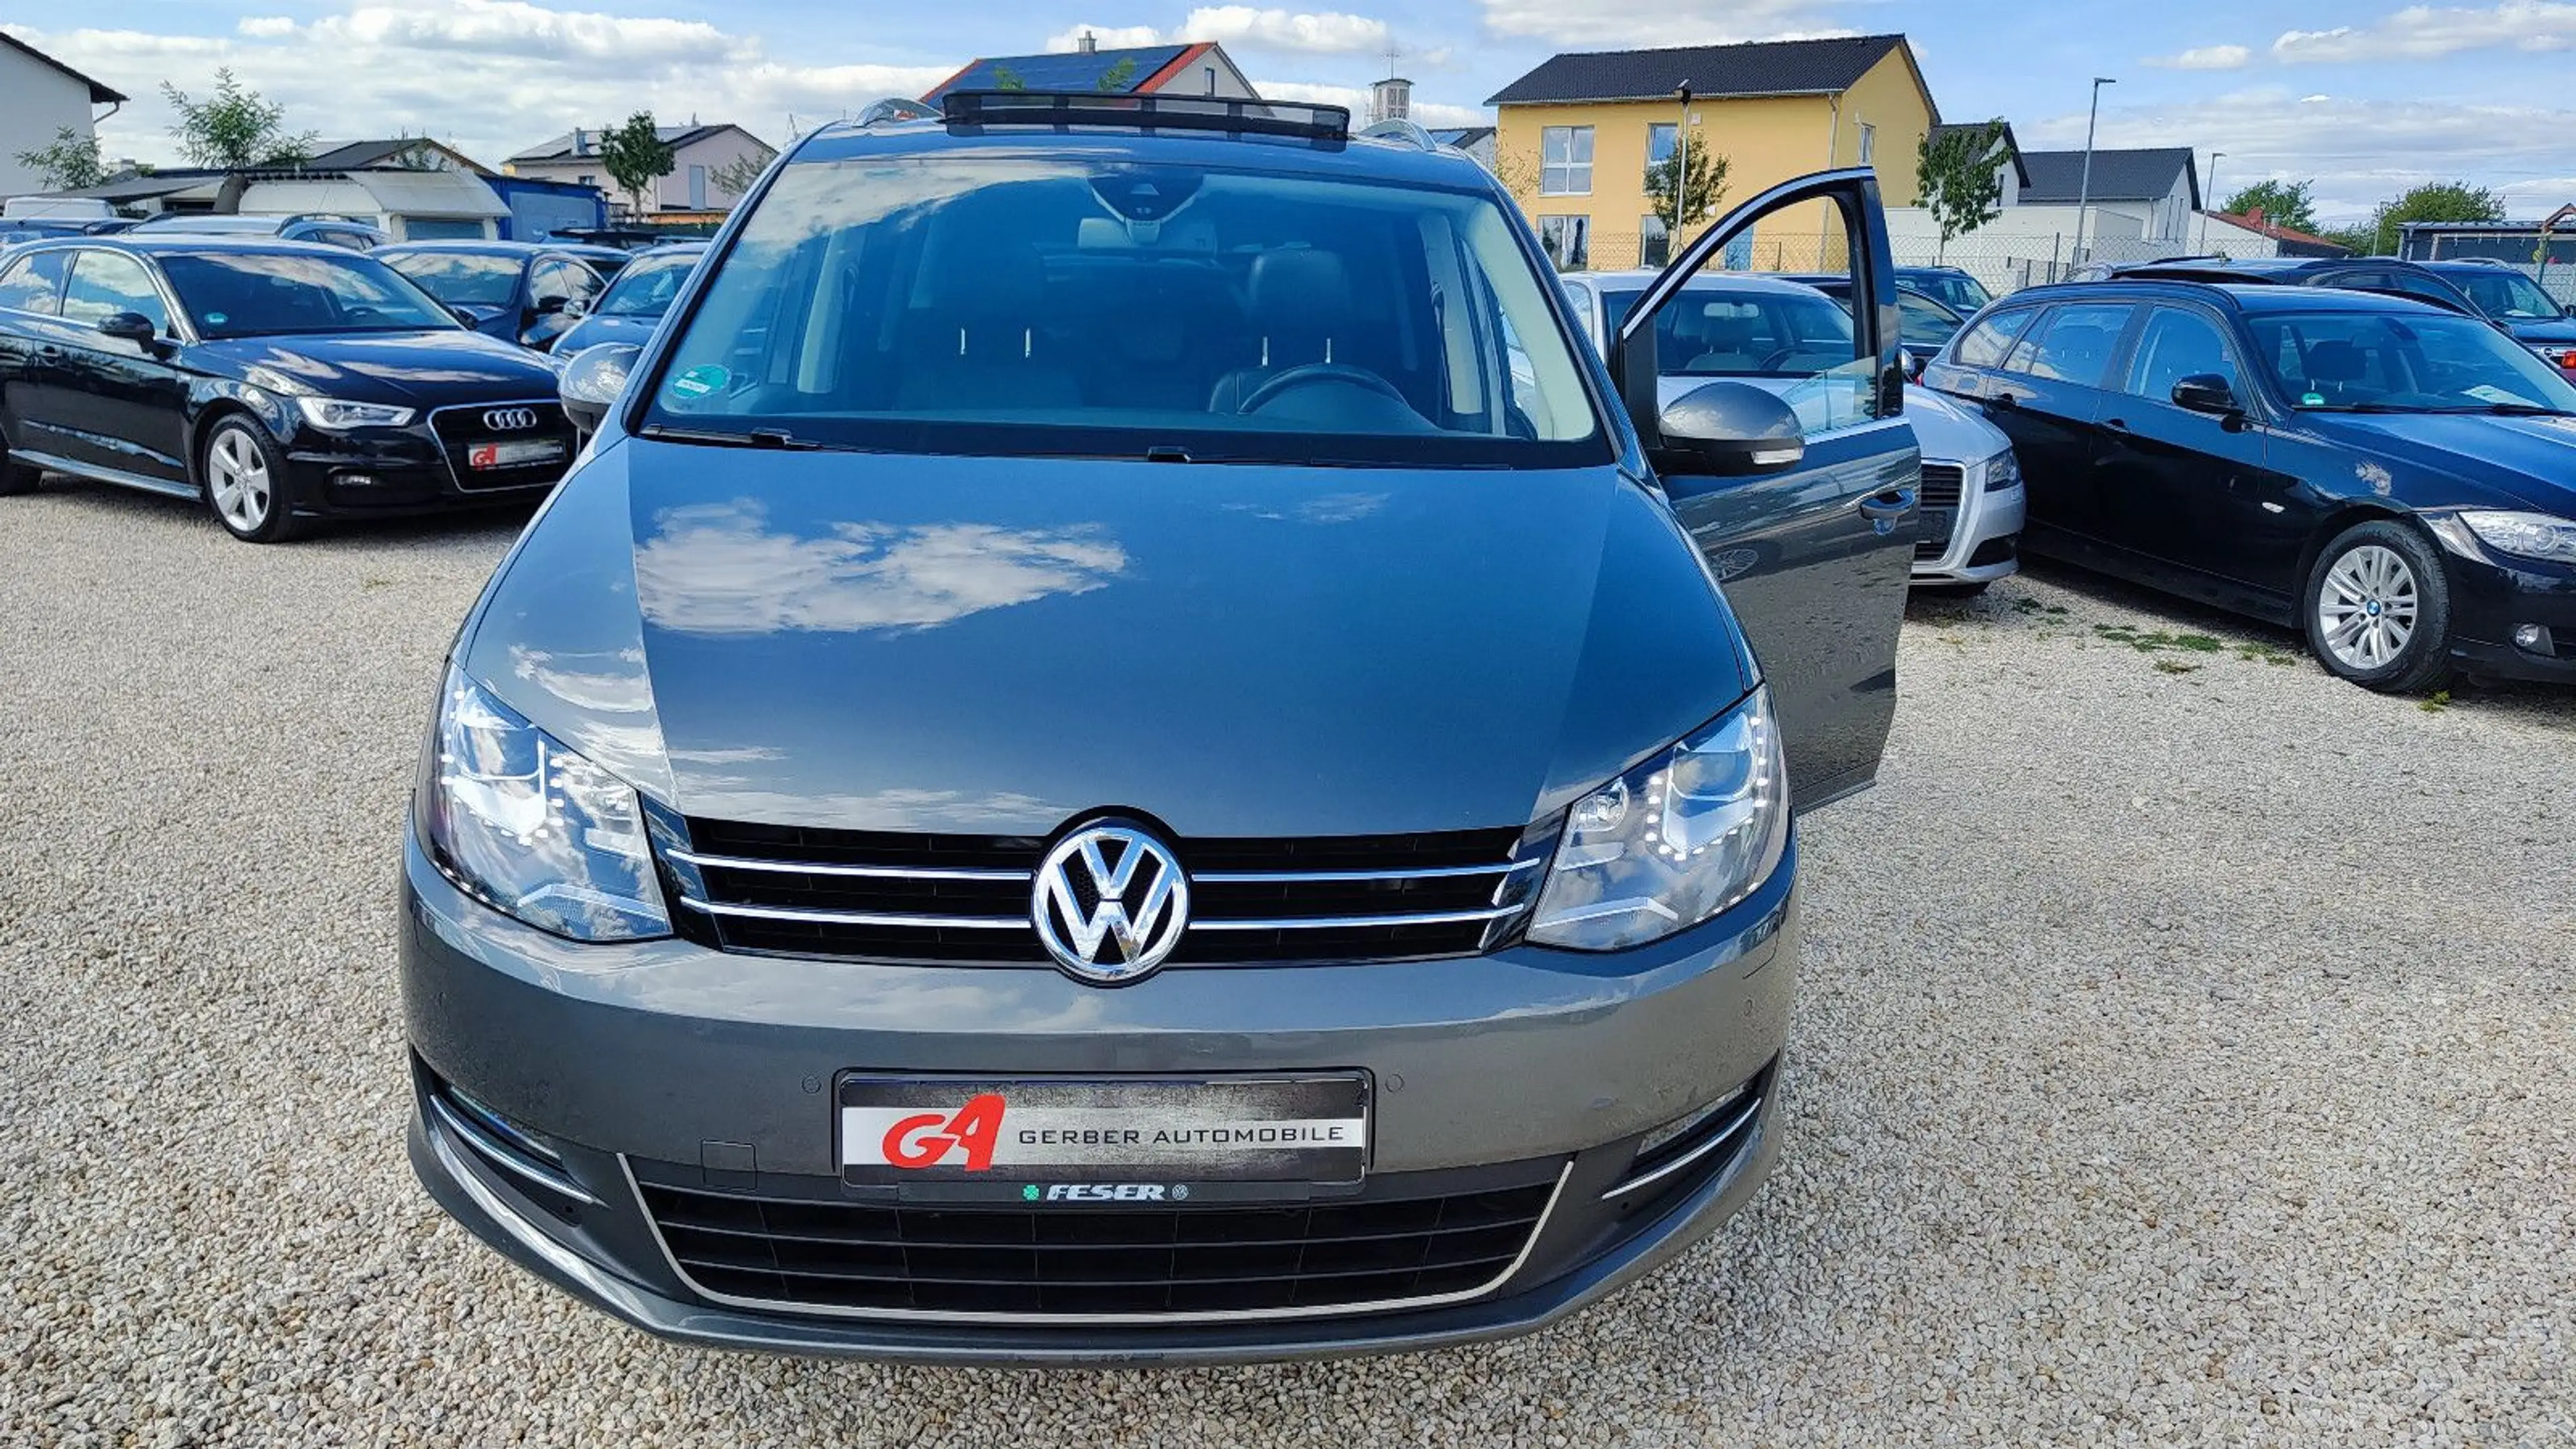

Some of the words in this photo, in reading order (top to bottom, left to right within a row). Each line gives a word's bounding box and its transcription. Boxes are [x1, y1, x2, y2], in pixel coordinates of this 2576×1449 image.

[882, 1095, 1006, 1171] GA
[1018, 1129, 1140, 1144] GERBER
[1152, 1126, 1344, 1144] AUTOMOBILE
[1046, 1184, 1166, 1201] FESER
